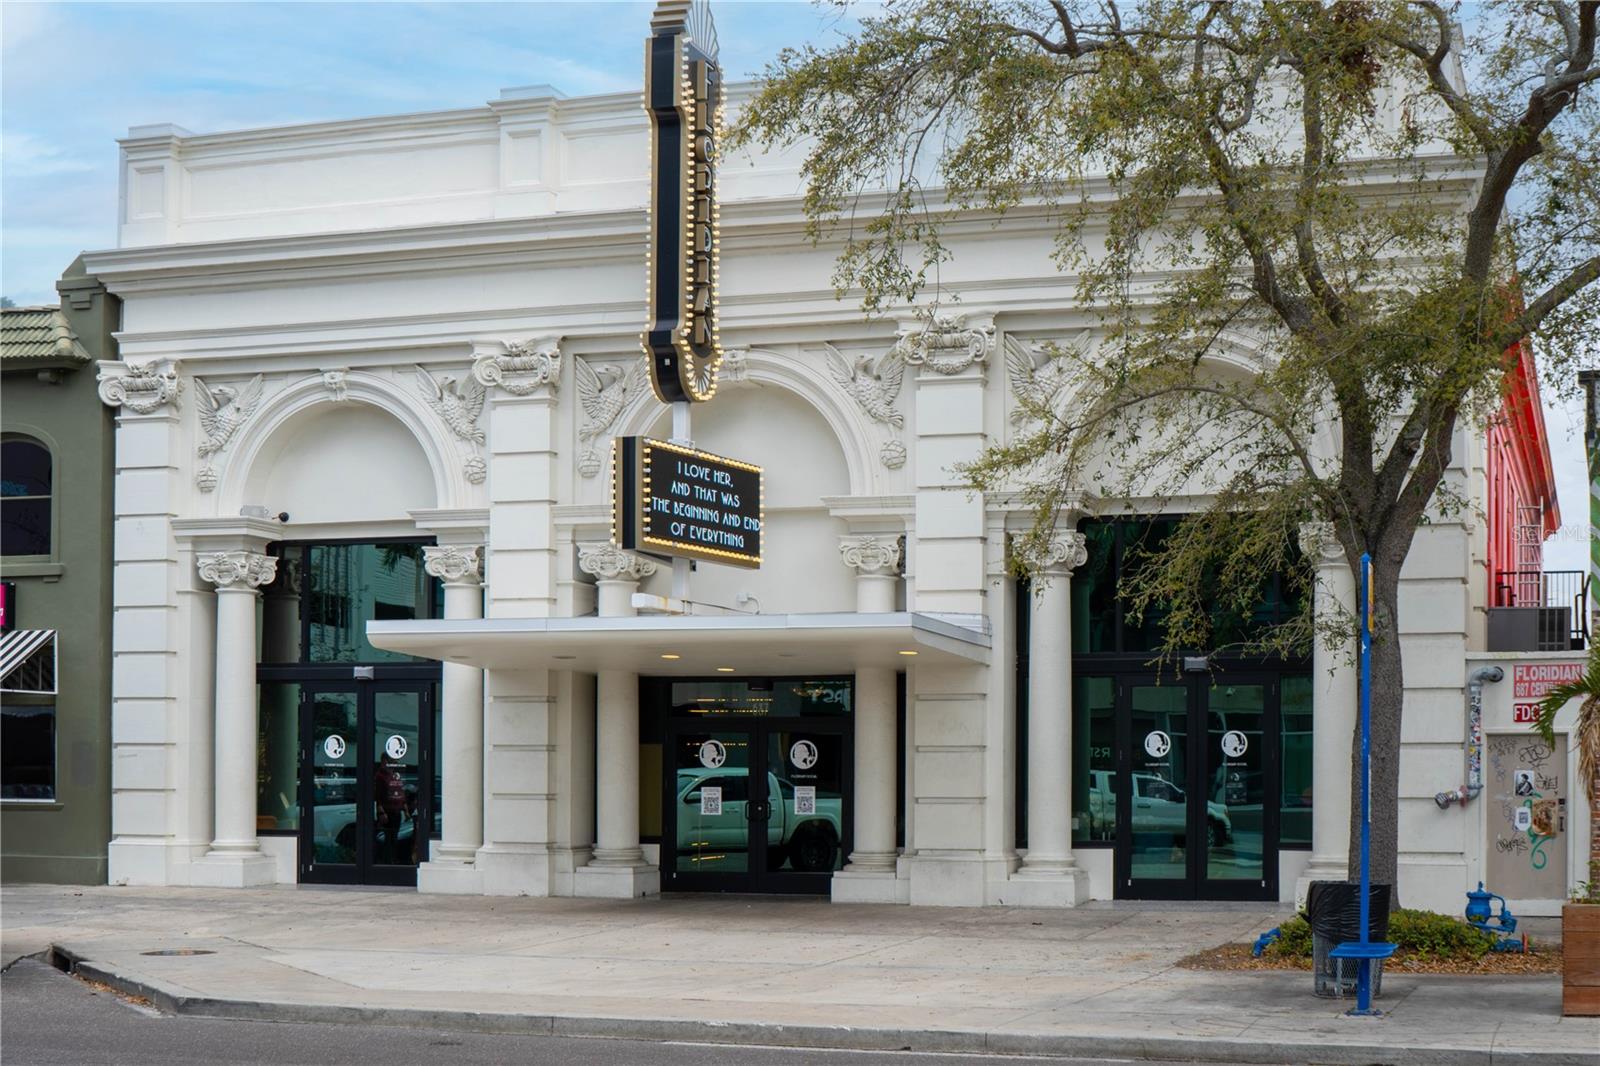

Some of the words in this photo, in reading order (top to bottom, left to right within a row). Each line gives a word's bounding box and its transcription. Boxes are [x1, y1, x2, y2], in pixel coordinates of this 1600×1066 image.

[696, 59, 716, 346] FLORIDIAN
[677, 461, 682, 475] I
[684, 463, 711, 481] LOVE
[713, 470, 734, 488] HER,
[671, 480, 691, 496] AND
[693, 485, 718, 503] THAT
[720, 492, 740, 508] WAS
[651, 496, 671, 513] THE
[673, 501, 720, 524] BEGINNING
[722, 512, 741, 528] AND
[743, 517, 761, 532] END
[670, 521, 687, 537] OF
[689, 525, 745, 548] EVERYTHING
[1515, 666, 1581, 681] FLORIDIAN
